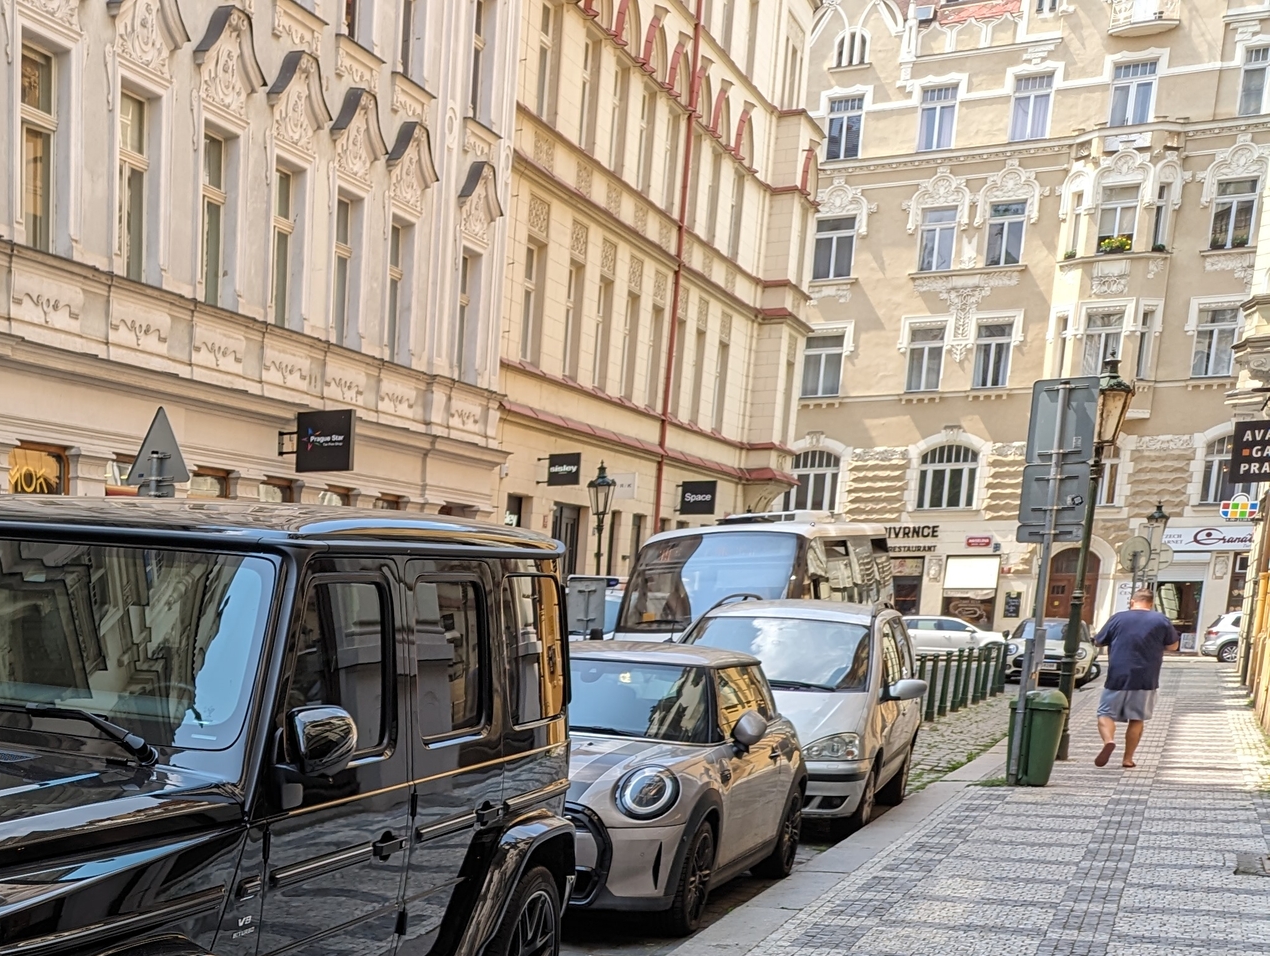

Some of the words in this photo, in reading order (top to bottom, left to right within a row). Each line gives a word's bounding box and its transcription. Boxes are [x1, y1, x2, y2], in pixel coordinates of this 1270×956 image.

[550, 464, 578, 473] sisley
[8, 464, 47, 493] MOK
[684, 493, 712, 503] Space
